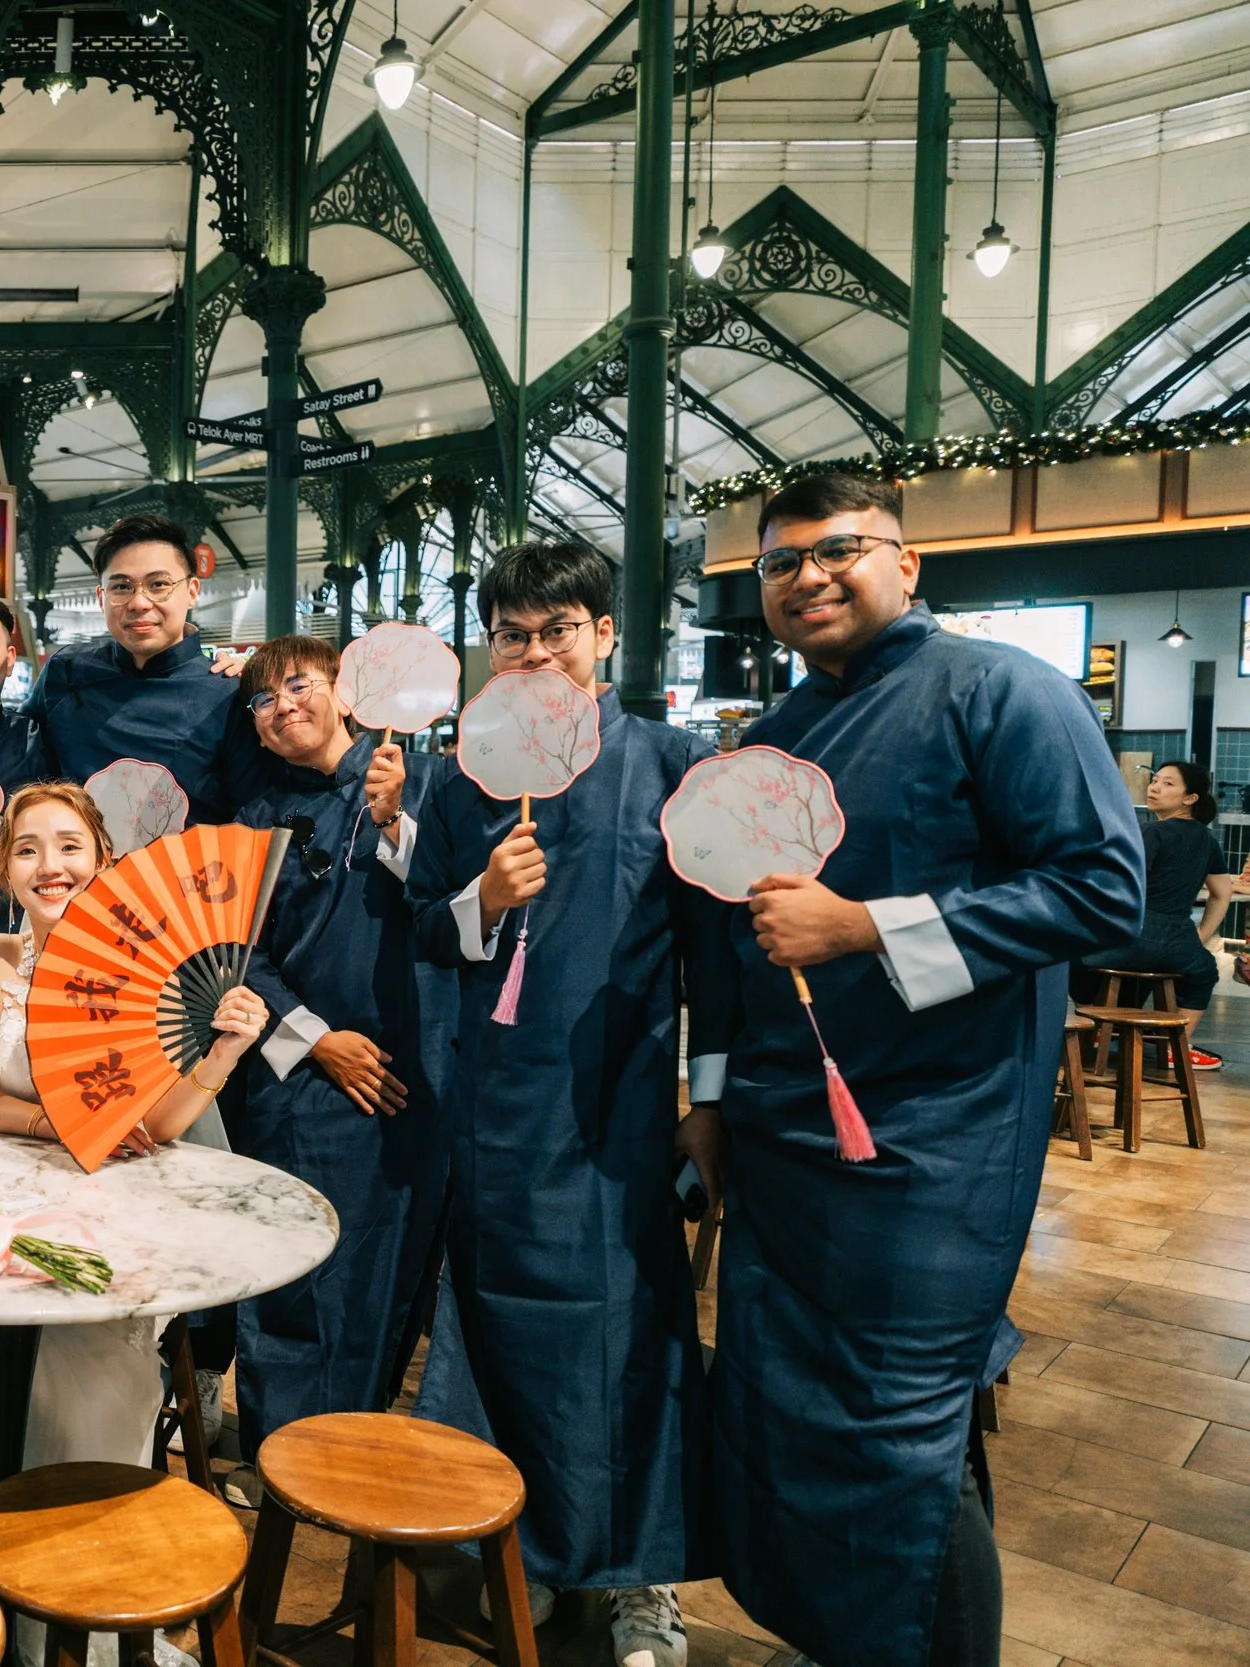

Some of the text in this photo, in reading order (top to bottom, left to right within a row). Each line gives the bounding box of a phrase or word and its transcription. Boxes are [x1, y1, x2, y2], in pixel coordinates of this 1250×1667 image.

[304, 389, 364, 414] Satay Street
[198, 424, 264, 445] Telok Ayer MRT
[304, 451, 358, 470] Restrooms
[63, 861, 238, 1113] 跟我走吧
